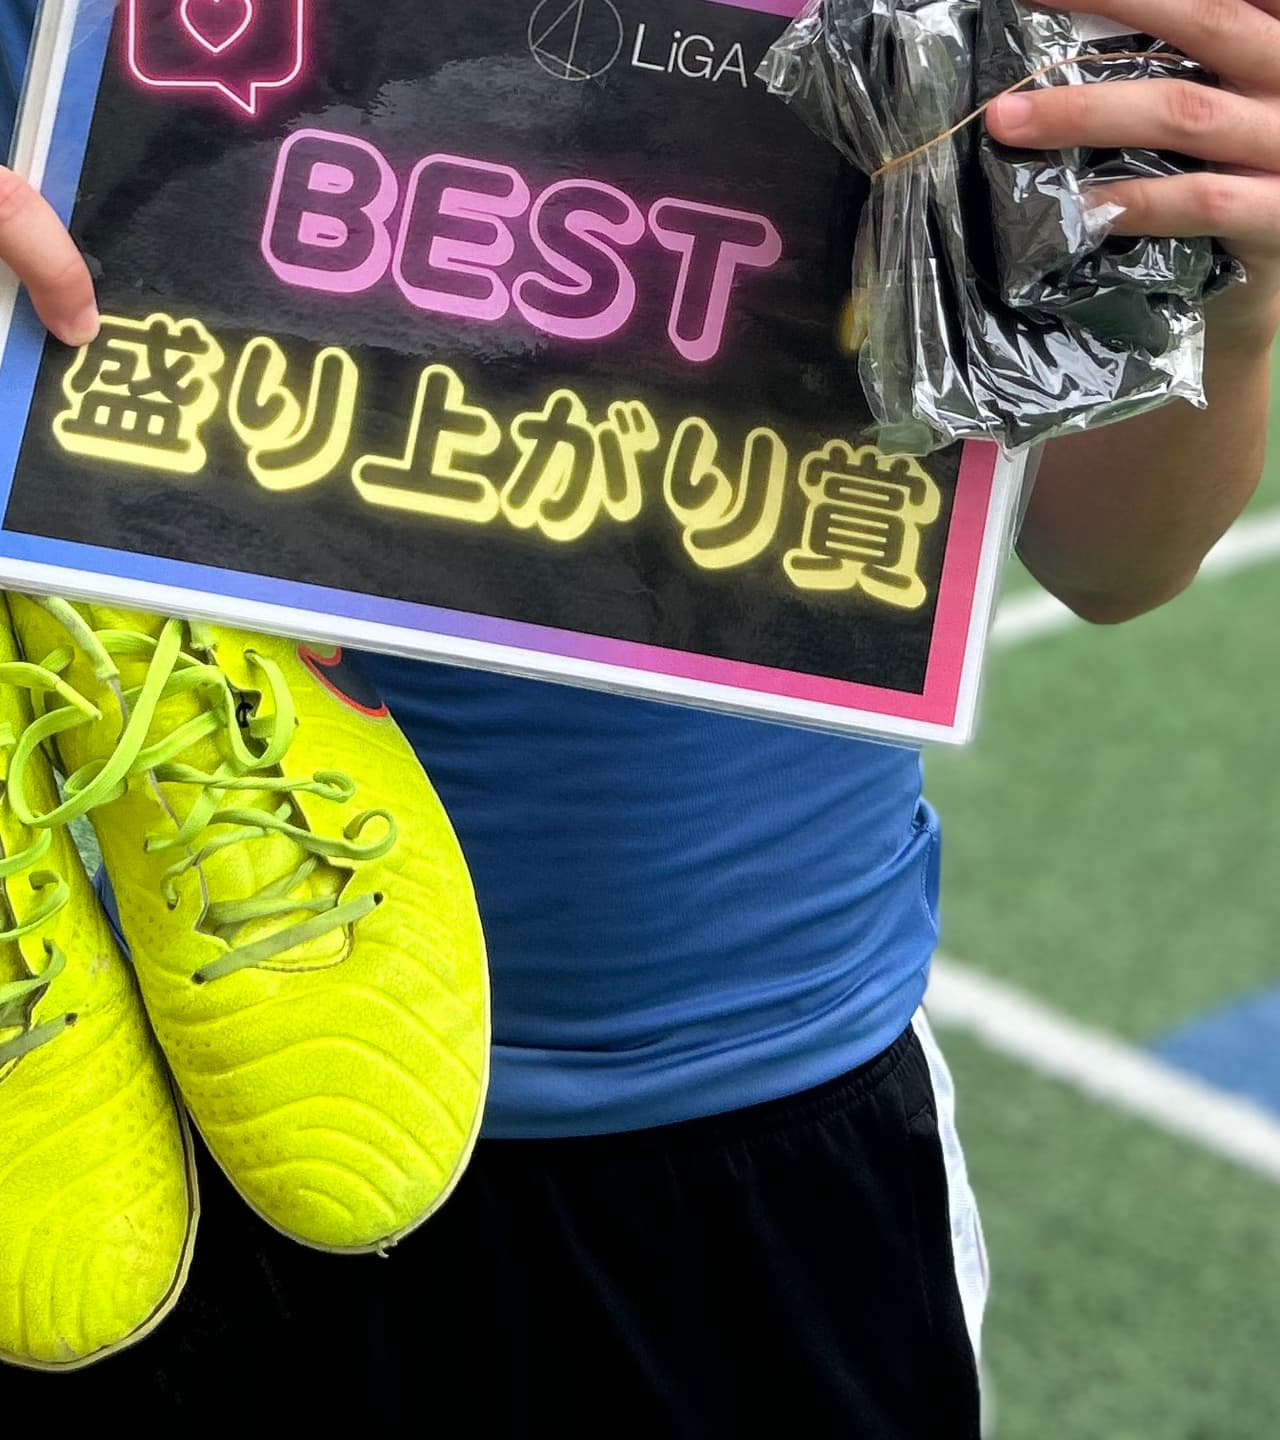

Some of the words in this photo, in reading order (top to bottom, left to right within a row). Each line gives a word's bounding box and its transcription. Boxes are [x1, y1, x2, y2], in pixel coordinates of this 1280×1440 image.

[261, 128, 783, 361] BEST
[52, 312, 942, 609] 盛り上がり賞
